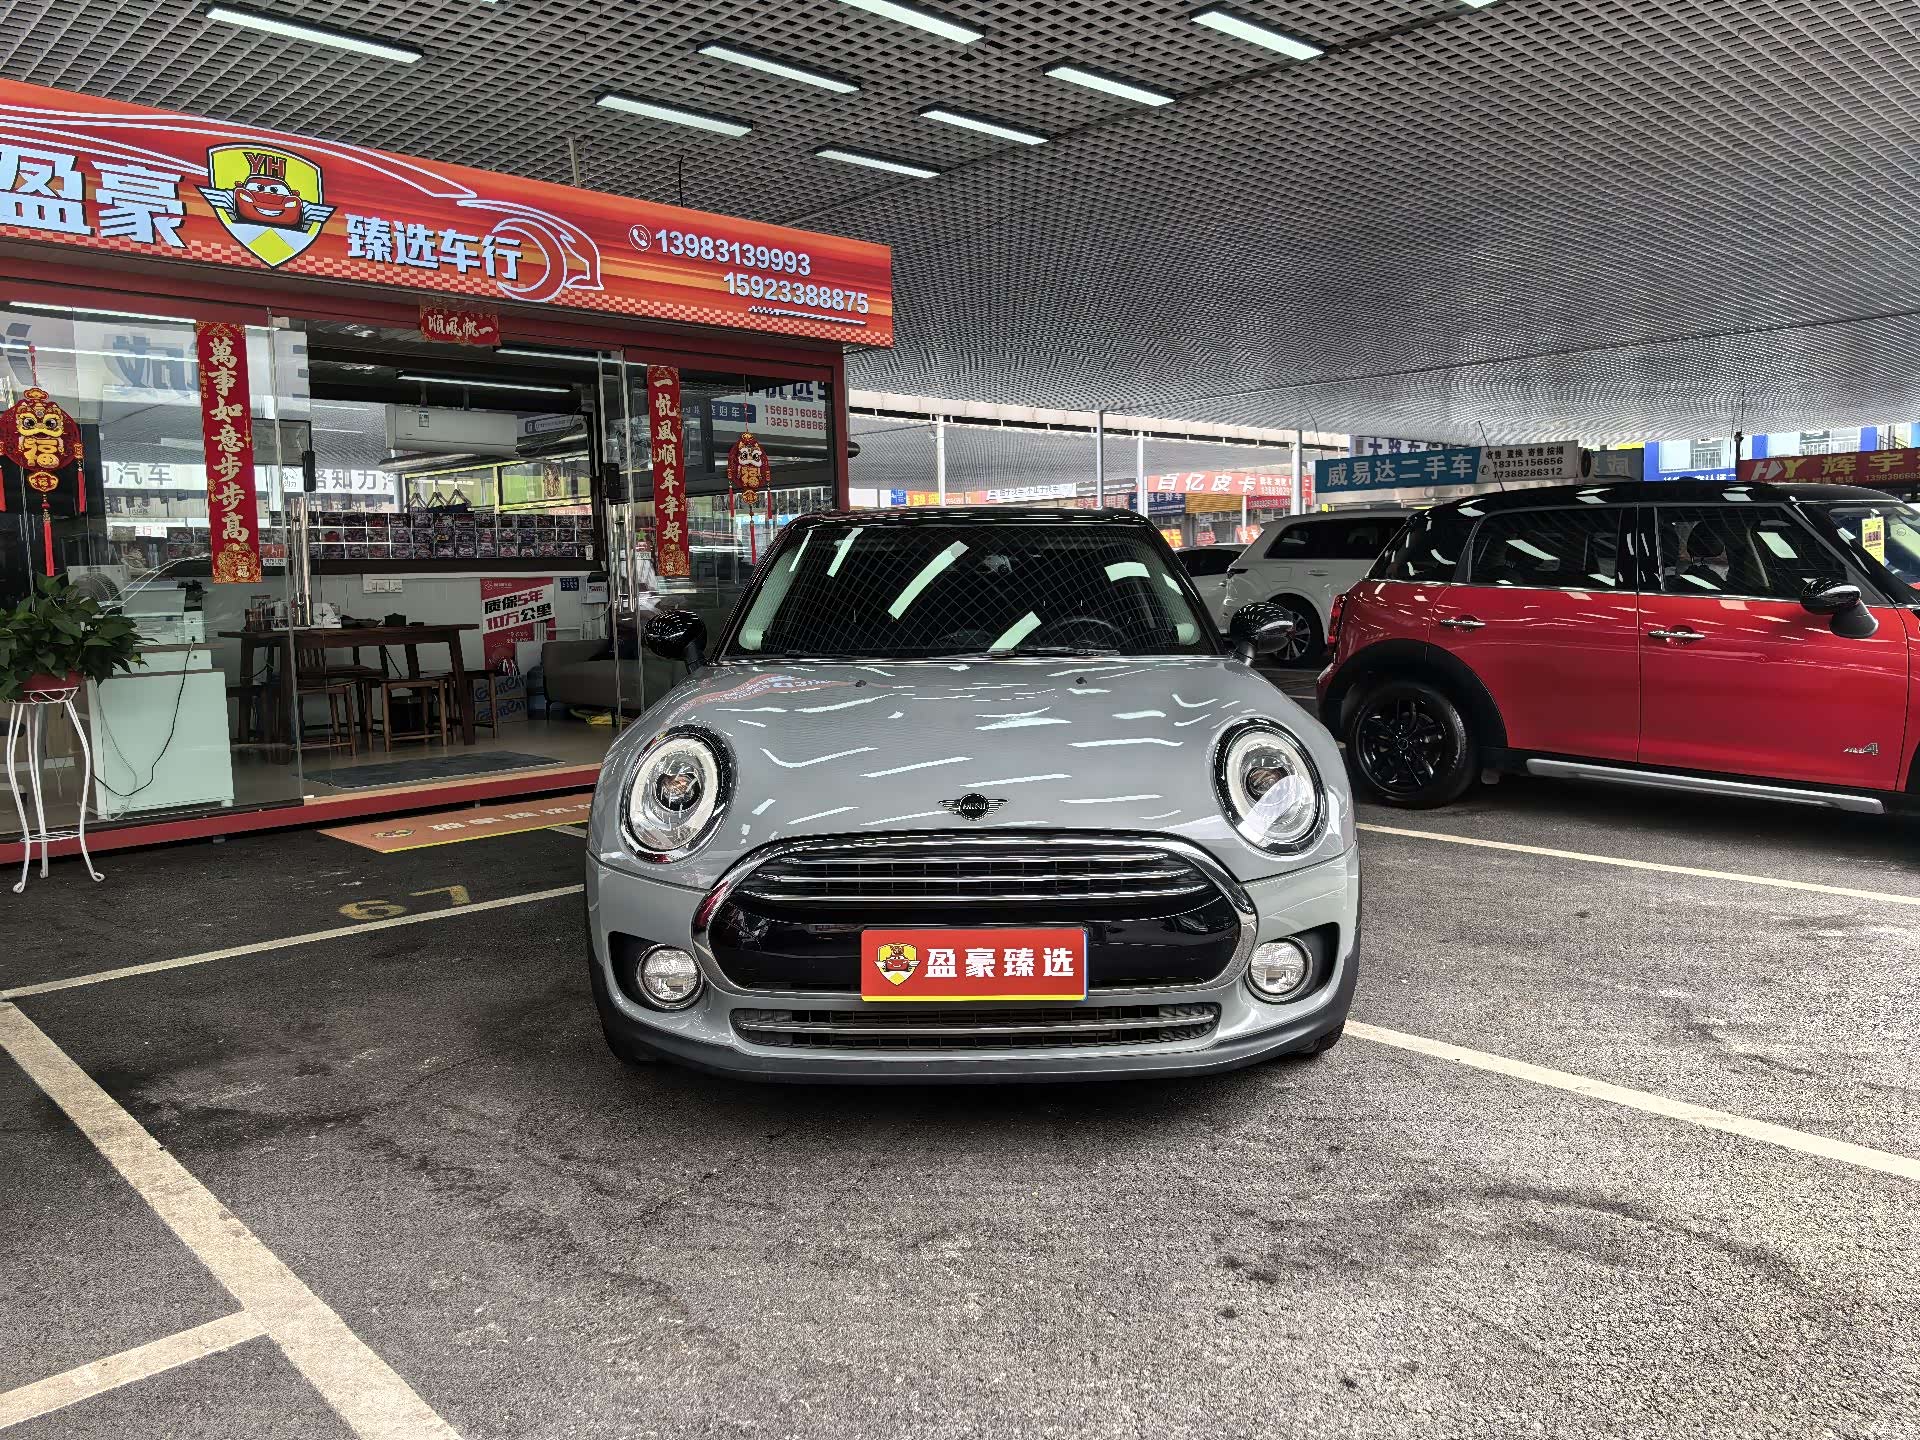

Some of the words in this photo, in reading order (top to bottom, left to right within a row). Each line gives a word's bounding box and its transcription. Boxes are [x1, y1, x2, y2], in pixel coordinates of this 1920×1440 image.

[243, 152, 287, 176] YH
[0, 143, 188, 248] 盈豪
[345, 212, 522, 281] 臻选车行
[655, 229, 812, 277] 13983139993
[723, 271, 869, 315] 15923388875
[1326, 453, 1473, 487] 威易达二手车
[1821, 451, 1920, 475] 辉宇
[1157, 473, 1256, 493] 百亿皮卡
[484, 588, 544, 615] 质保5年
[486, 602, 553, 630] 10万公里
[338, 884, 472, 920] 67
[924, 947, 1075, 978] 盈豪臻选
